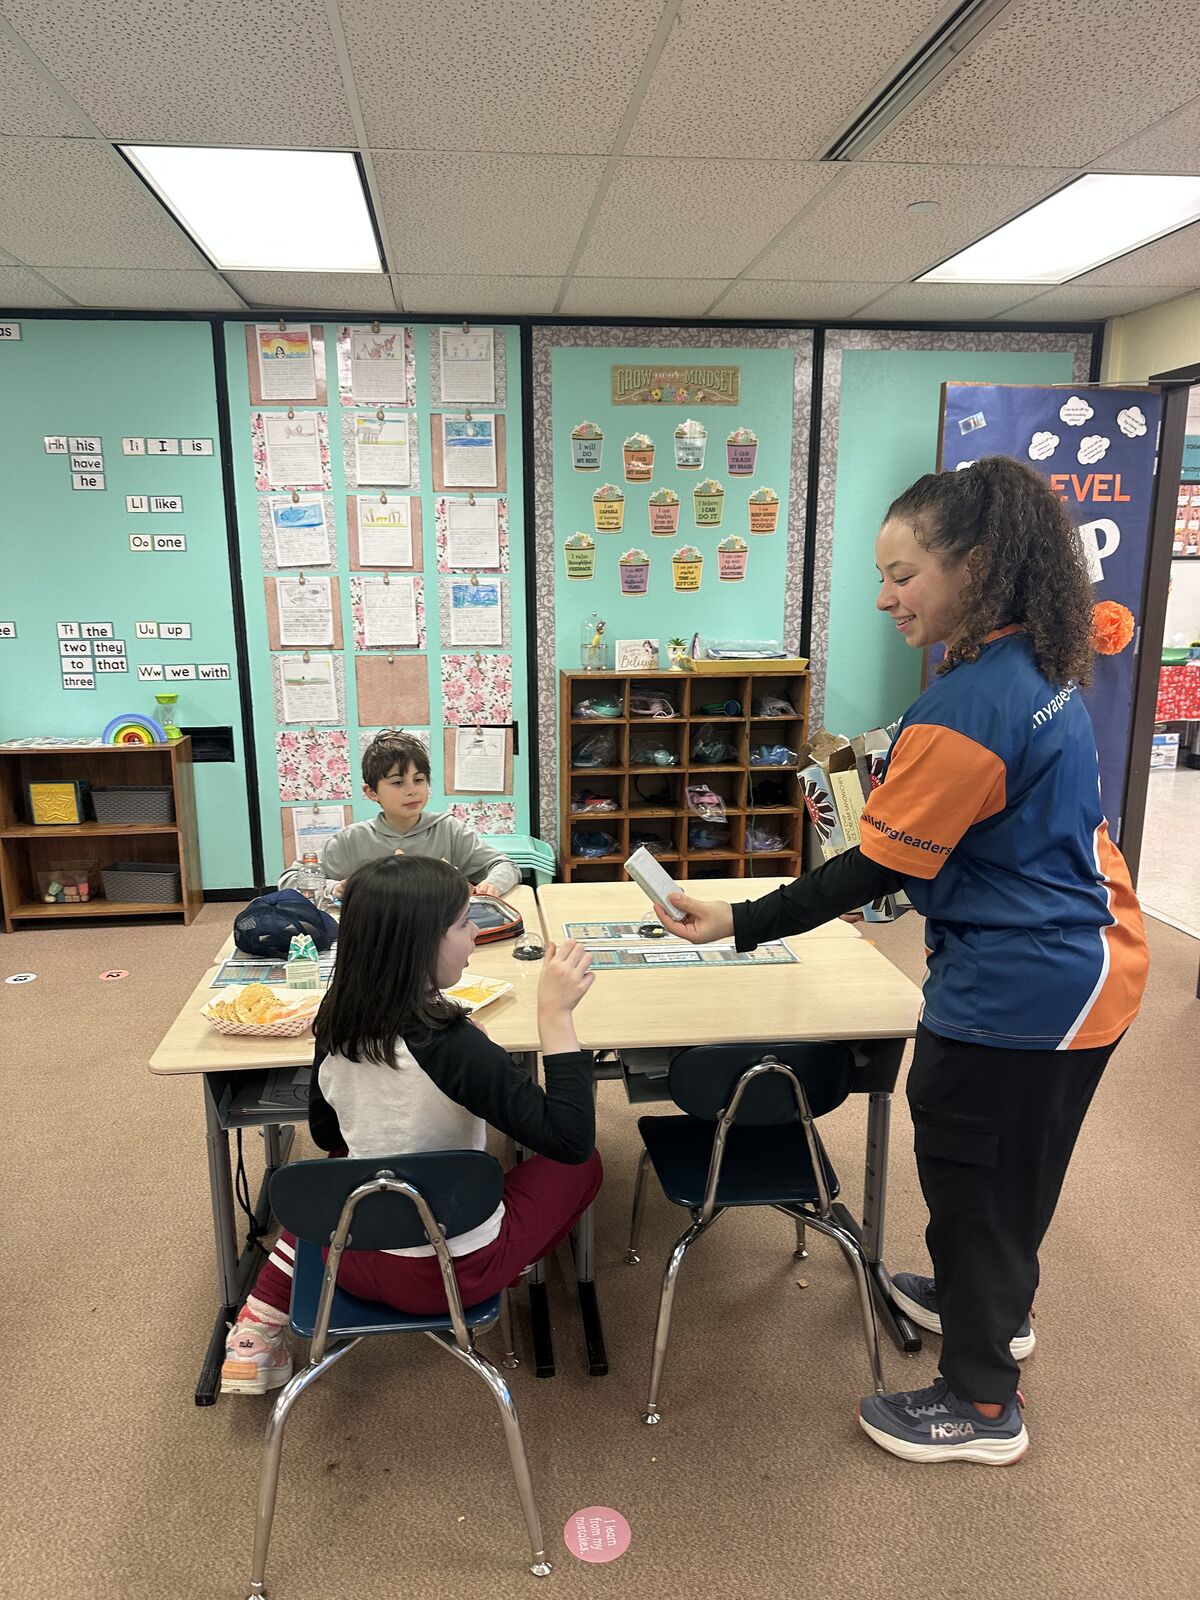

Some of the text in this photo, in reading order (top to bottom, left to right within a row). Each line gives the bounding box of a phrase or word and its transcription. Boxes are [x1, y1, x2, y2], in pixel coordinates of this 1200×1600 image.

[617, 369, 735, 395] GROW MINDSET
[48, 440, 95, 451] Hh his
[159, 441, 168, 452] I
[192, 440, 202, 450] is
[74, 458, 101, 468] have
[81, 476, 97, 486] he
[1050, 473, 1132, 502] EVEL
[156, 498, 177, 509] like
[132, 537, 182, 548] Oo one
[62, 624, 108, 637] Tt the
[139, 624, 182, 637] Uu up
[64, 642, 123, 654] two they
[70, 660, 125, 670] to that
[140, 667, 228, 678] Ww we with
[64, 678, 93, 687] three
[838, 776, 850, 812] SANDWICHES
[846, 812, 855, 832] CREAM
[861, 814, 953, 855] uildingleaders
[239, 1339, 254, 1348] nike
[931, 1422, 975, 1440] HOKA
[576, 1516, 590, 1554] mistakes.
[590, 1517, 602, 1550] from my
[605, 1526, 616, 1546] learn
